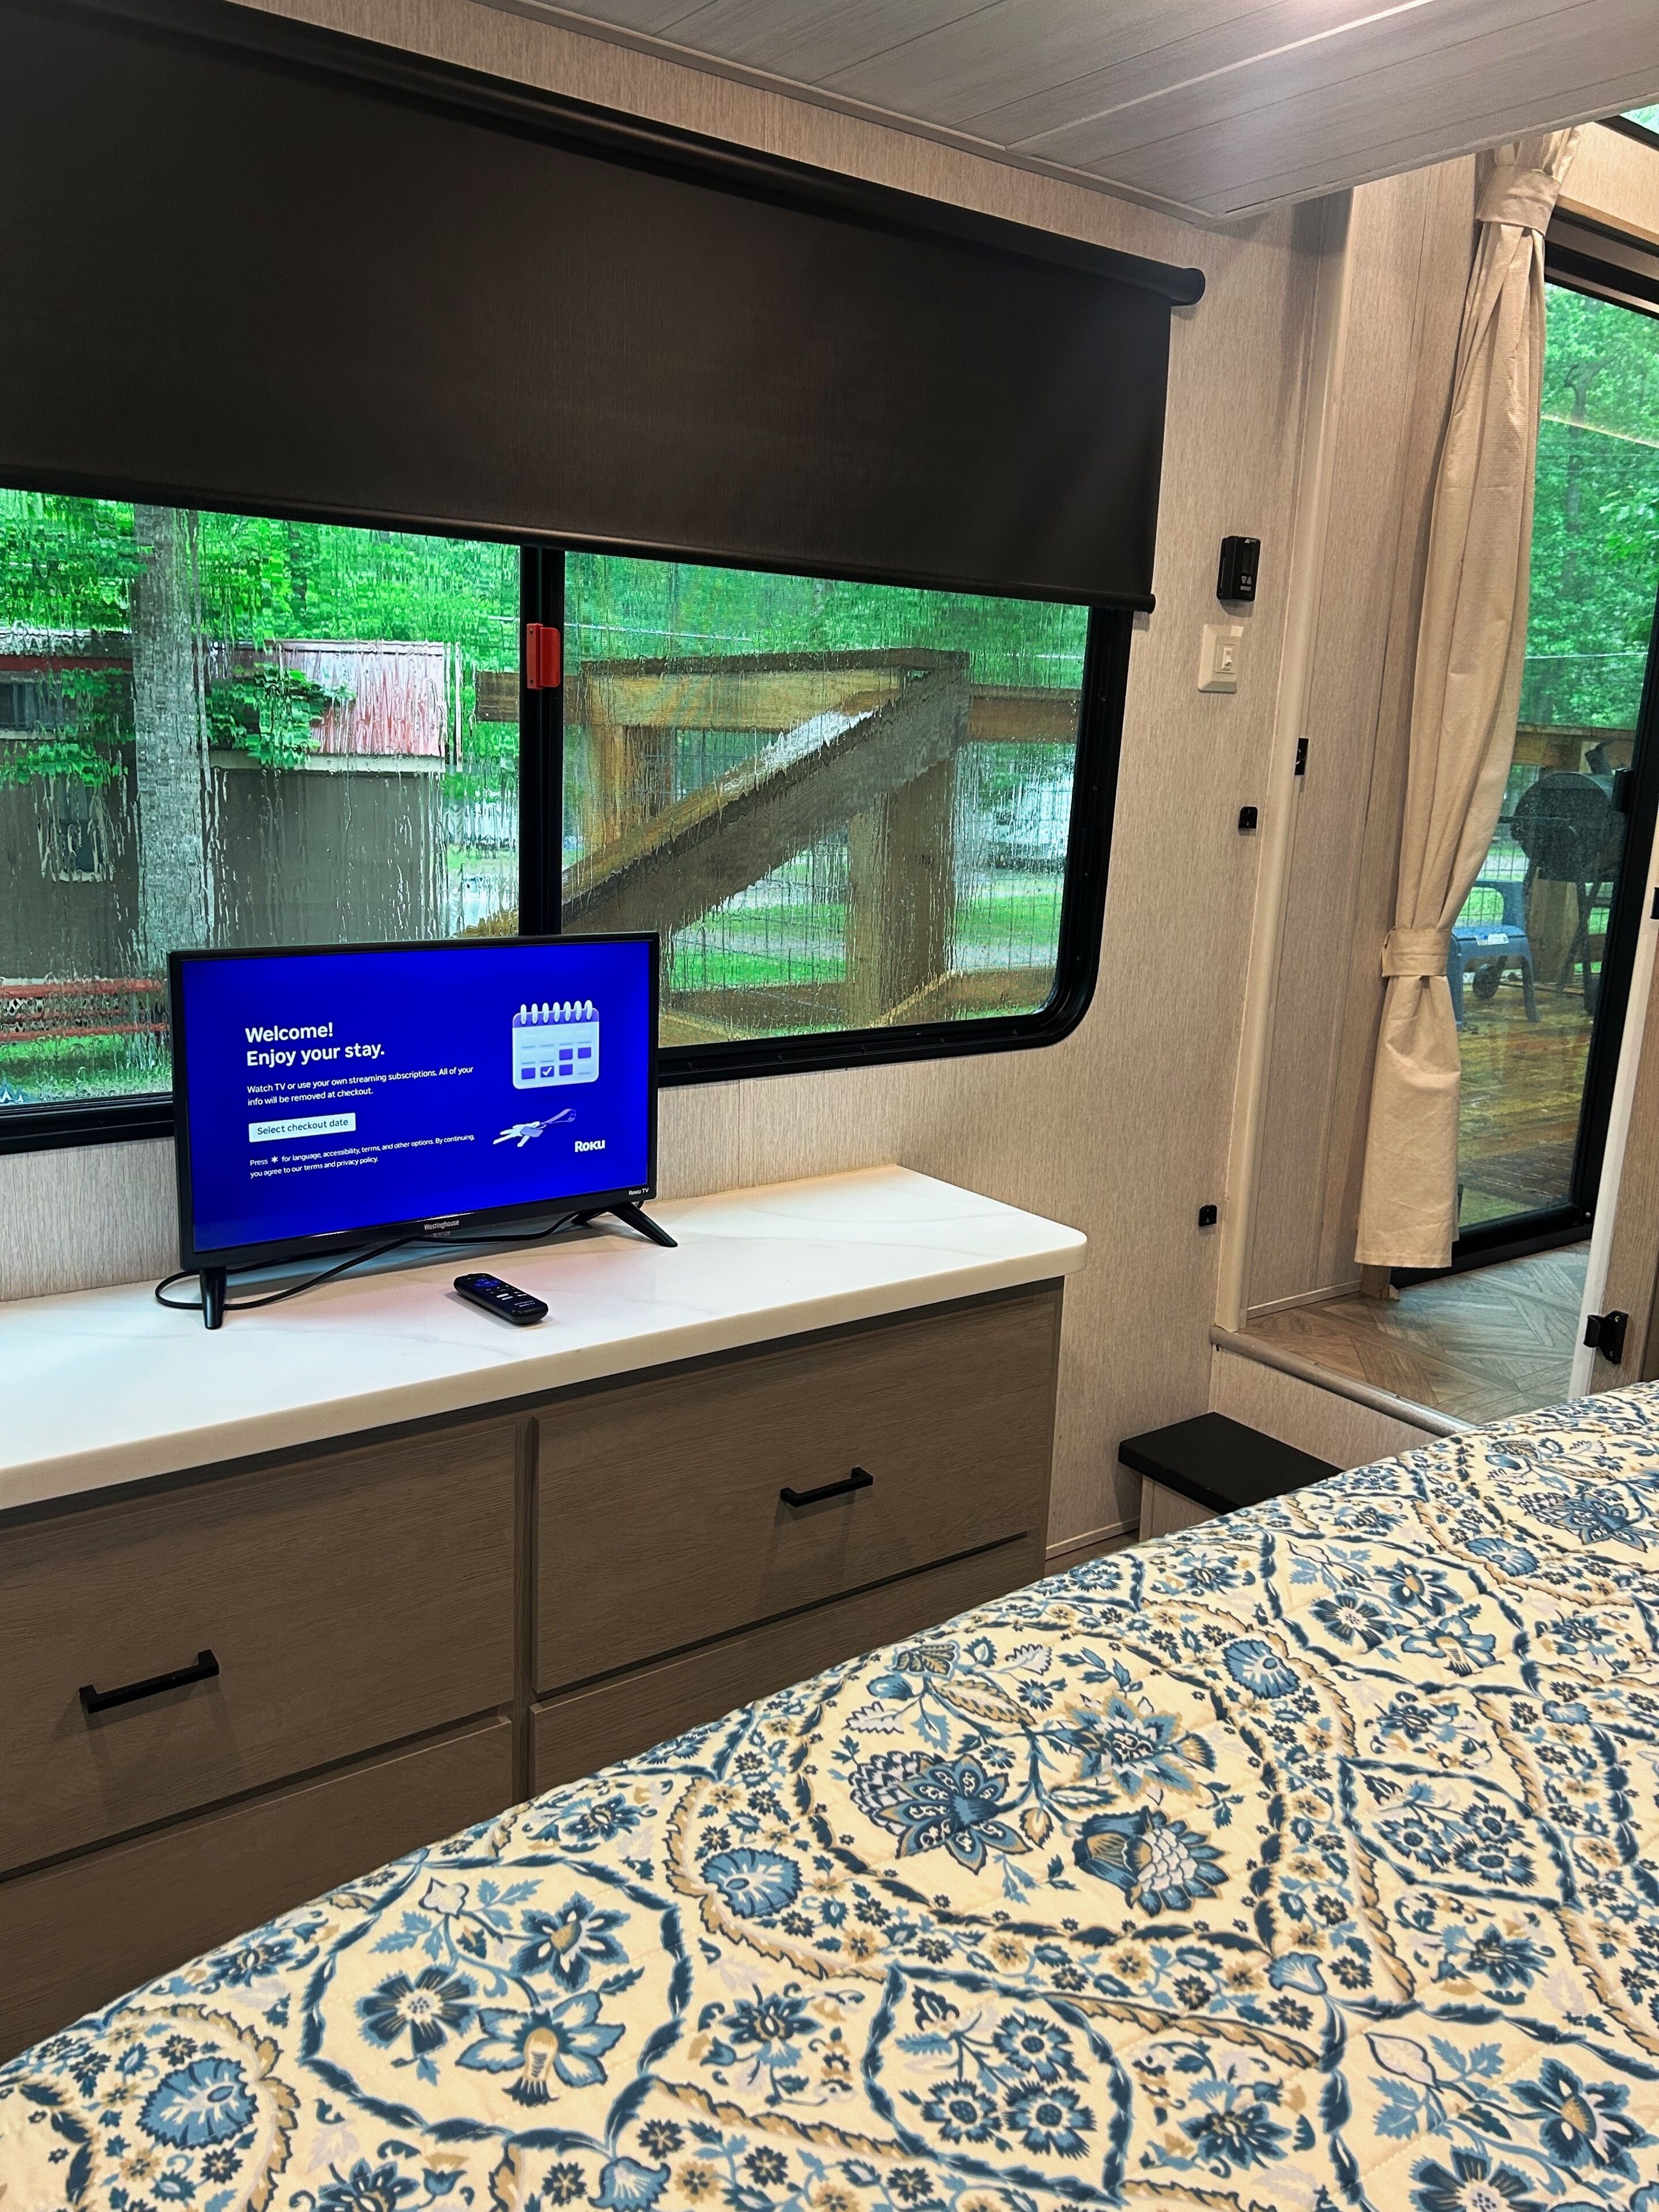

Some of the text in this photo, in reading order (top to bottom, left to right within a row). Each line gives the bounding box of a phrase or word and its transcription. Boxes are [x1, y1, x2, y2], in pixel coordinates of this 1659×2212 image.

[245, 1022, 333, 1043] Welcome!
[247, 1043, 385, 1068] Enjoy your stay.
[247, 1084, 273, 1093] Watch
[313, 1080, 330, 1089] your
[349, 1074, 387, 1084] streaming
[388, 1070, 437, 1081] subscriptions.
[439, 1068, 448, 1076] All
[458, 1066, 474, 1075] your
[248, 1097, 263, 1105] info
[264, 1096, 277, 1104] will
[291, 1091, 325, 1101] removed
[337, 1087, 373, 1097] checkout.
[257, 1119, 349, 1135] Select checkout date
[292, 1153, 322, 1161] language,
[323, 1148, 361, 1157] accessibility,
[411, 1139, 434, 1147] options.
[264, 1168, 282, 1176] agree
[336, 1158, 359, 1168] privacy
[359, 1157, 378, 1165] policy.
[424, 1220, 460, 1230] Westinghouse
